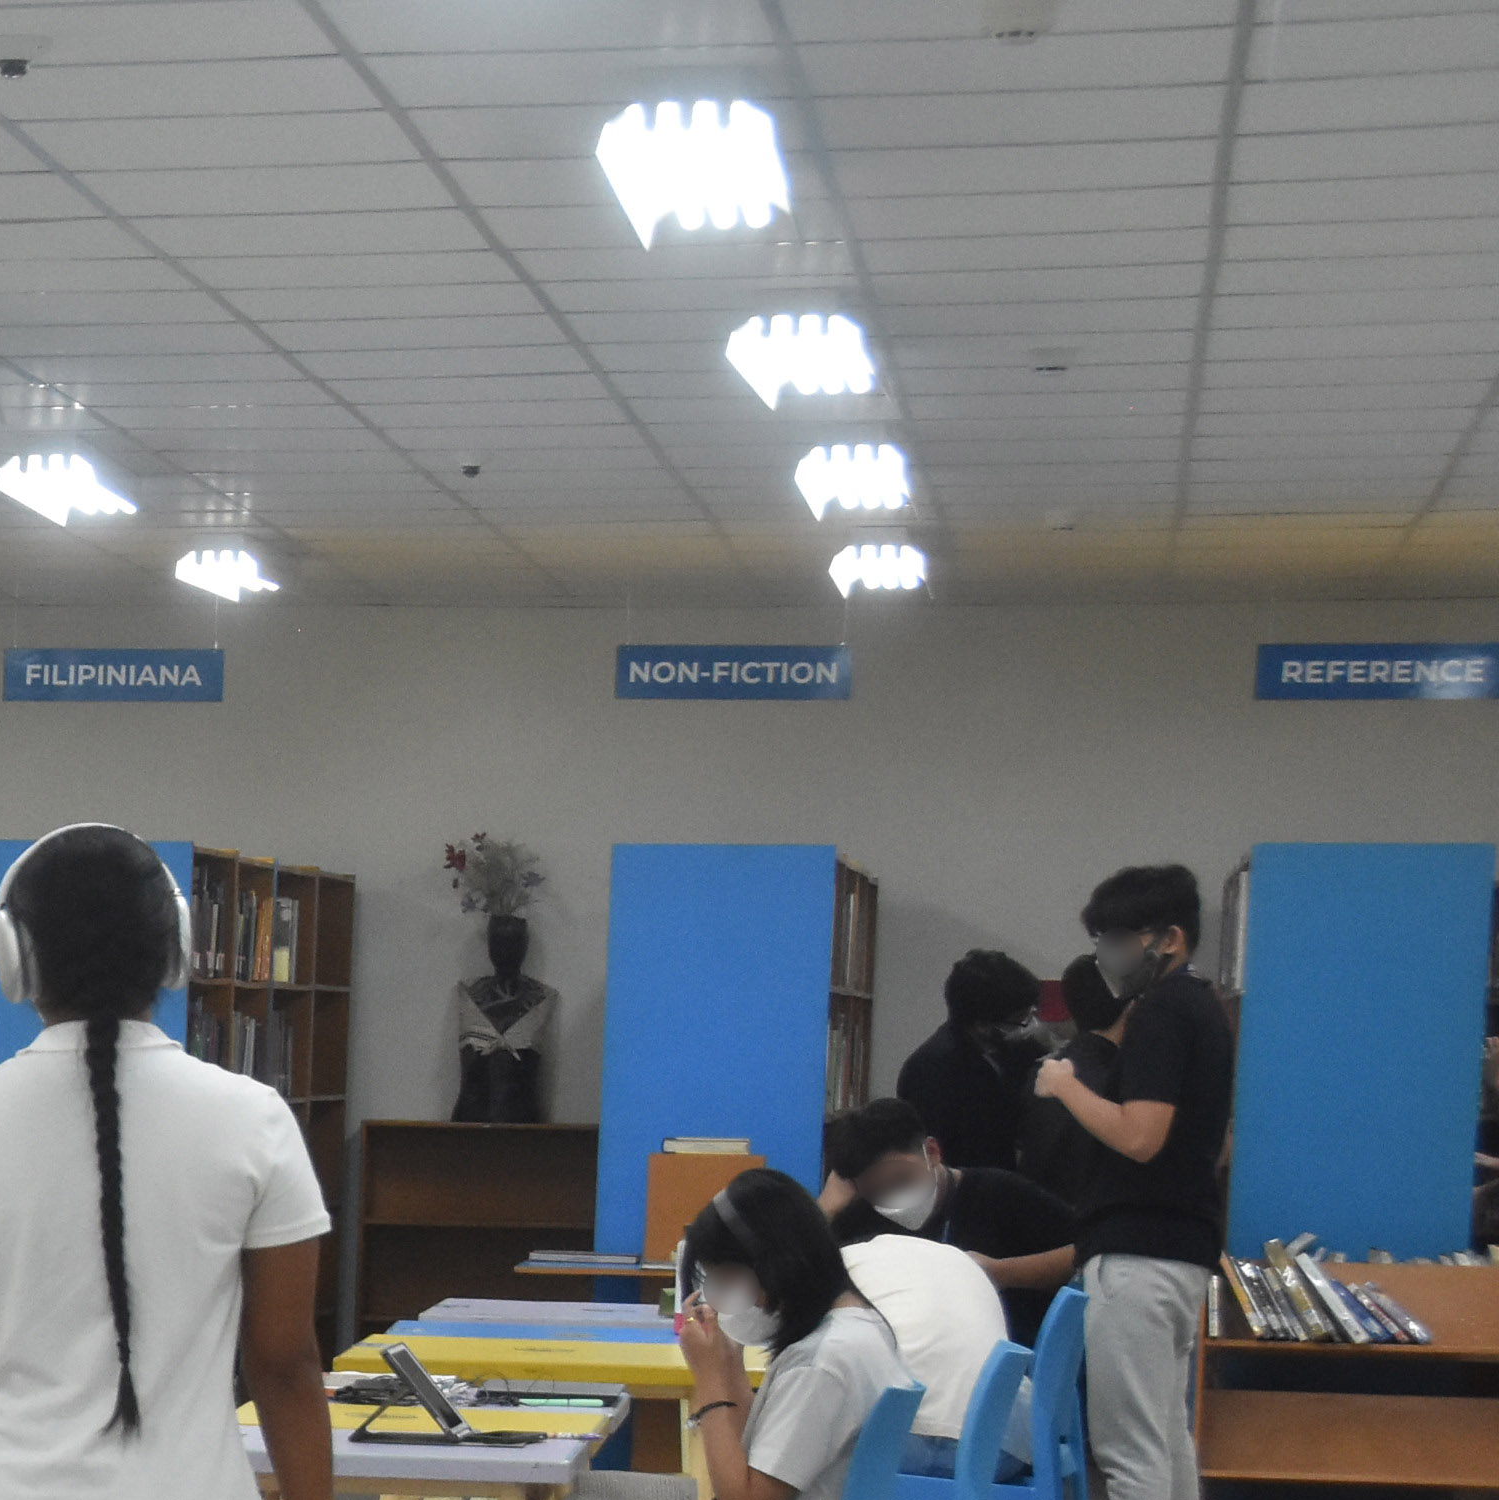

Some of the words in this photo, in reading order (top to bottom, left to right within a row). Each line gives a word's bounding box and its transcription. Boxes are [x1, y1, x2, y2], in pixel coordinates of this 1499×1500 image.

[25, 664, 202, 686] FILIPINIANA
[629, 661, 839, 684] NON-FICTION
[1281, 660, 1485, 683] REFERENCE
